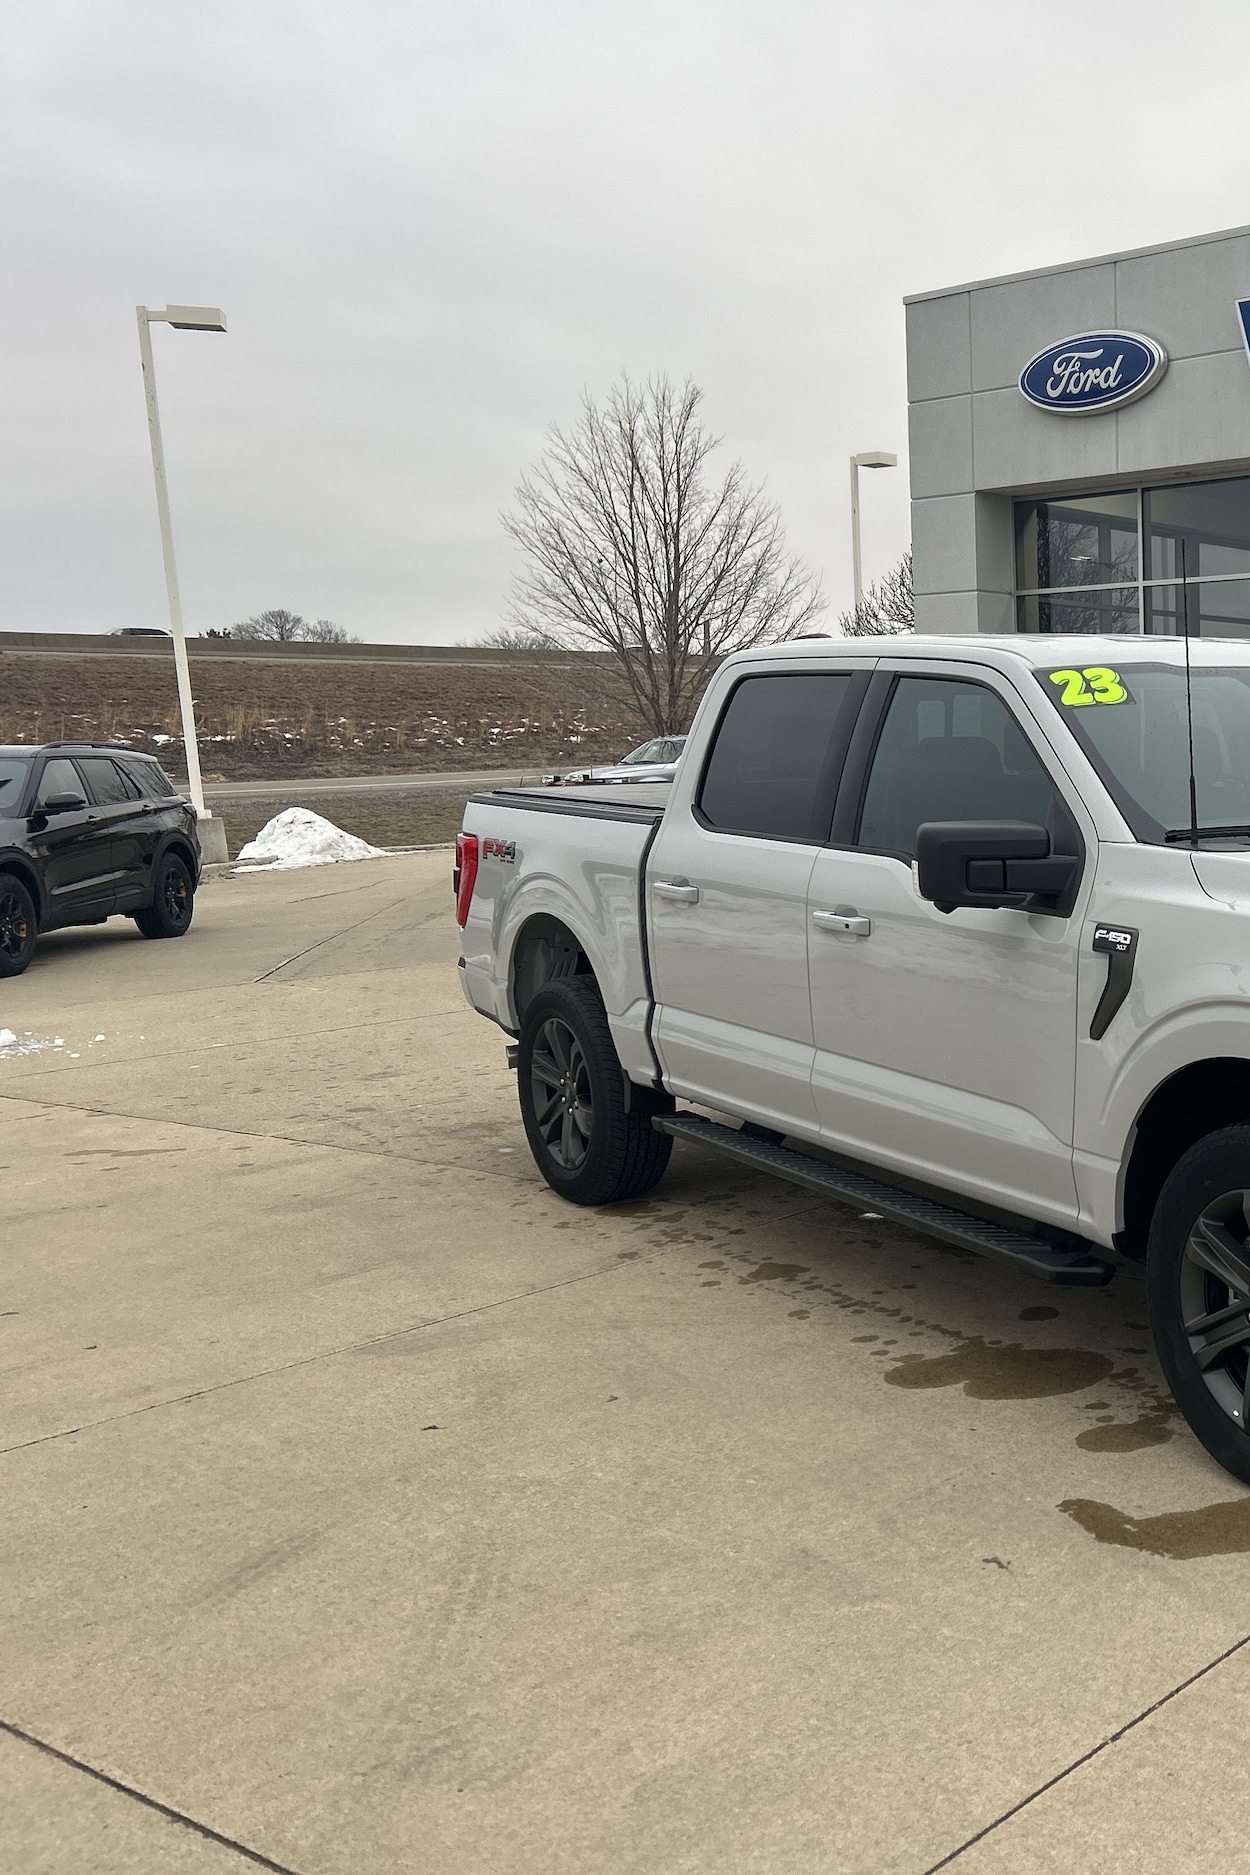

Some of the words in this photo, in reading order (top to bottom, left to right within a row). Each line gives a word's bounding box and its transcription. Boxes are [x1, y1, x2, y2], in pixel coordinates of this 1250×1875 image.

[1046, 348, 1124, 398] Ford
[1048, 667, 1128, 707] 23
[482, 837, 517, 860] FX4
[1095, 929, 1132, 945] F-150
